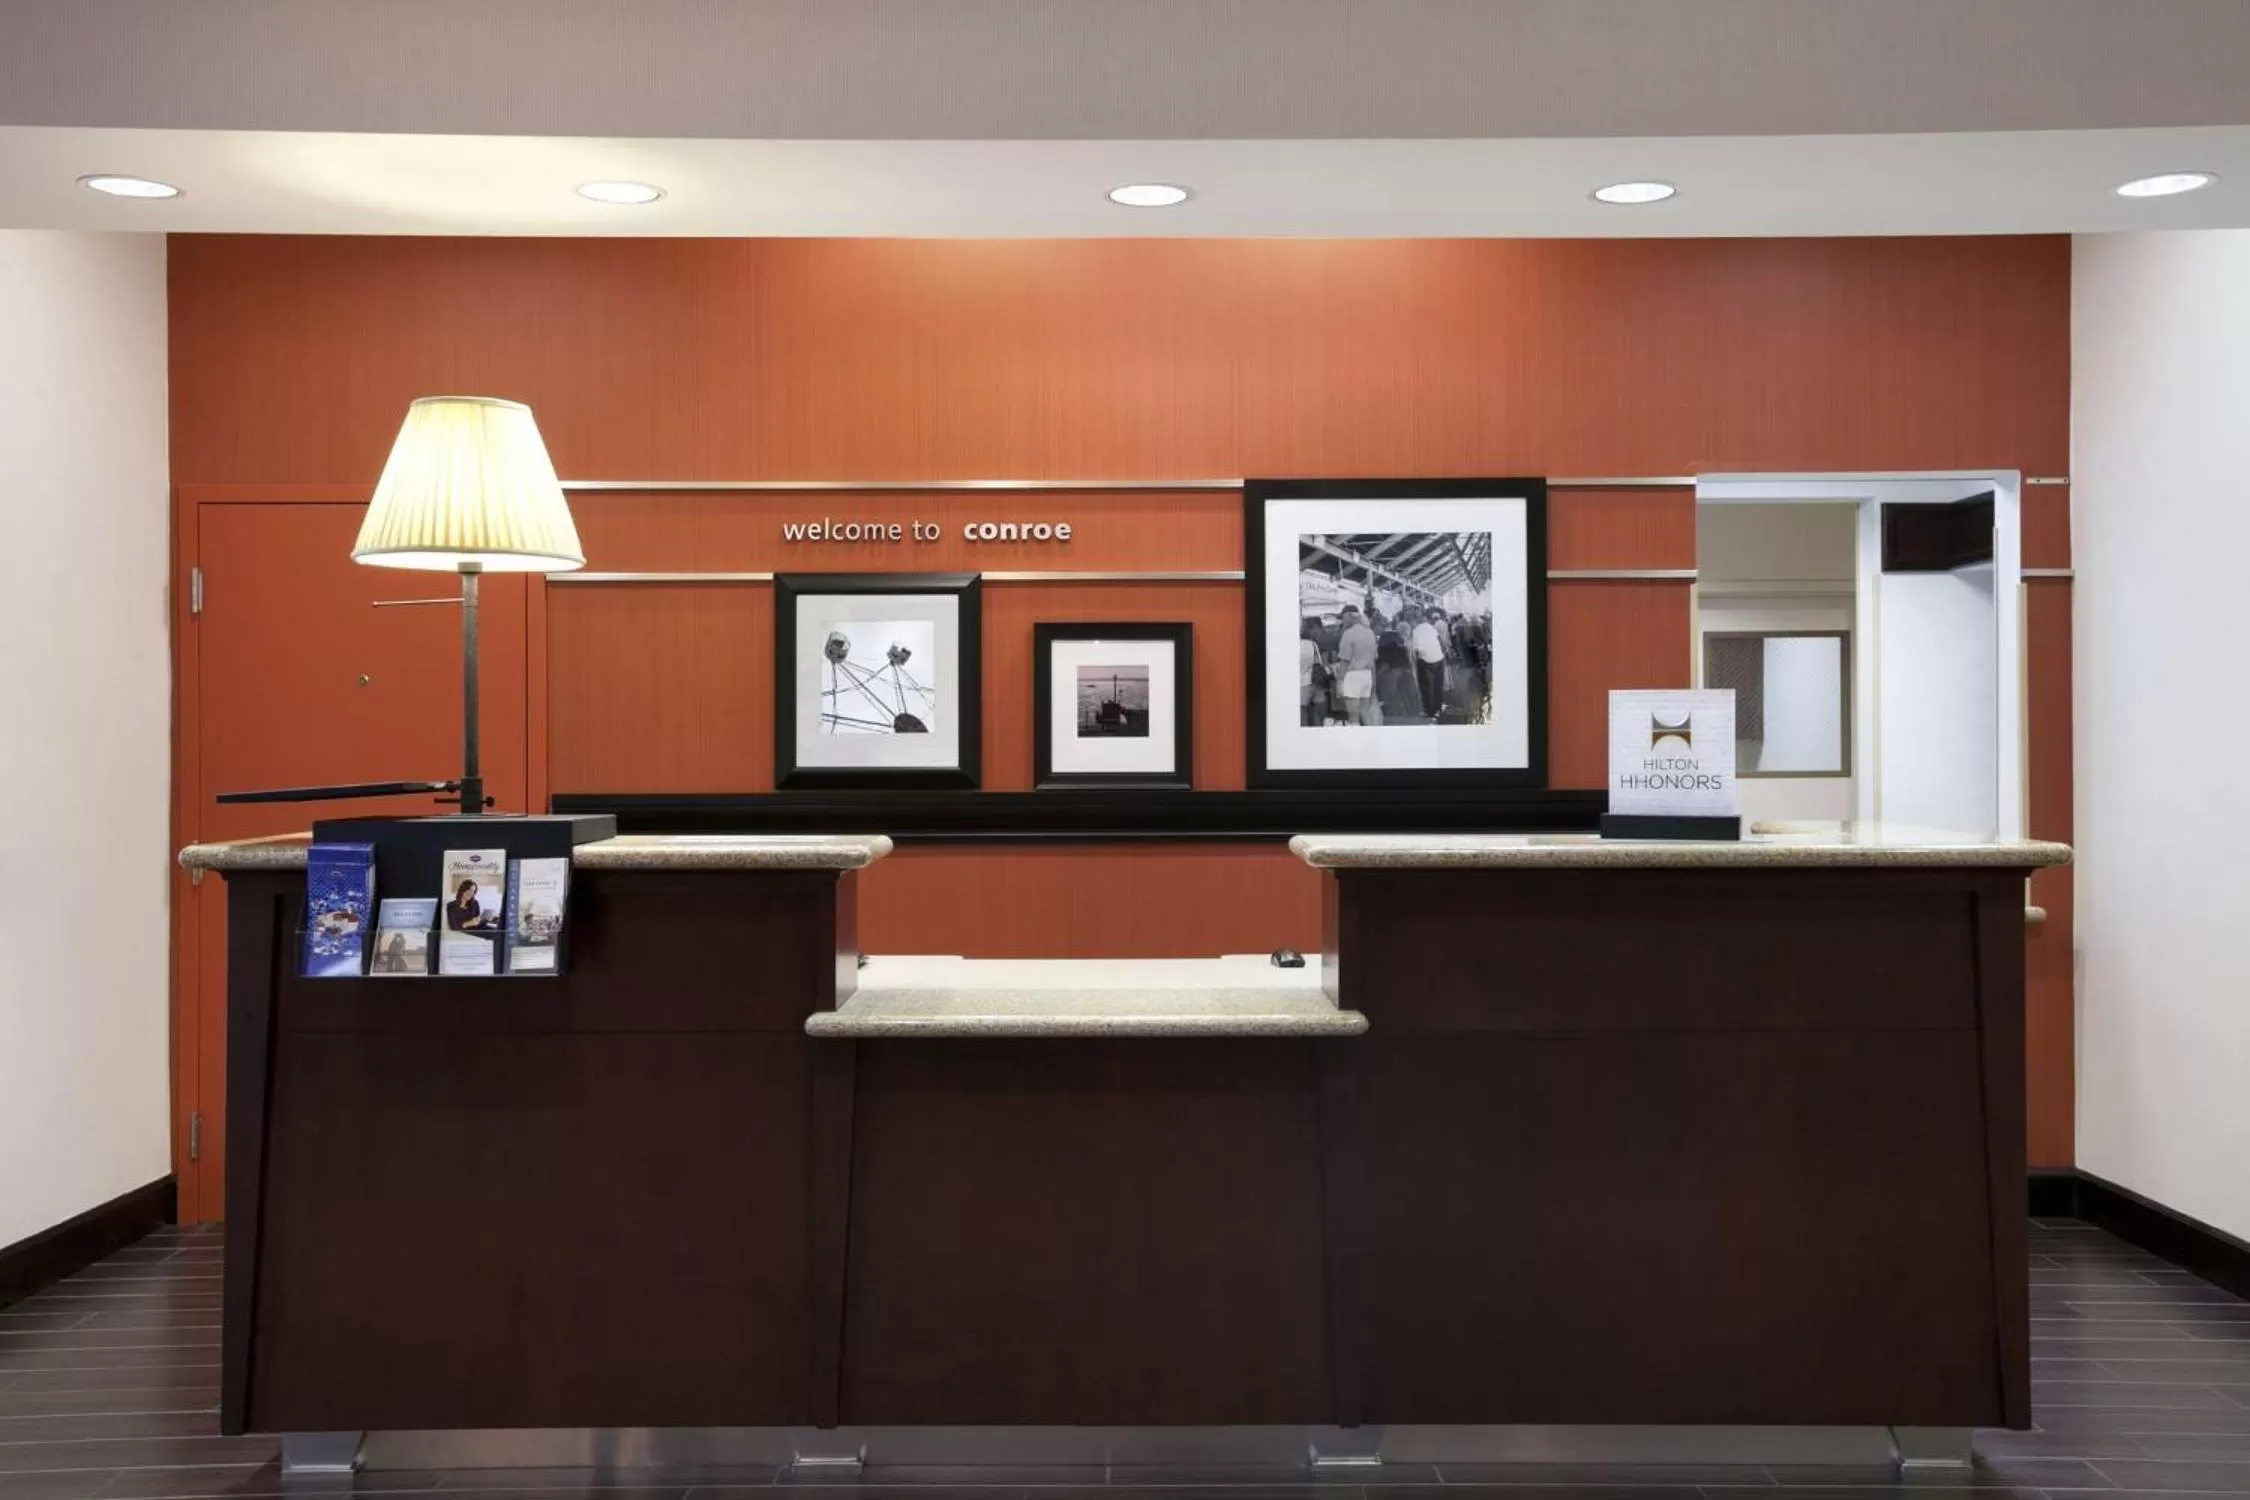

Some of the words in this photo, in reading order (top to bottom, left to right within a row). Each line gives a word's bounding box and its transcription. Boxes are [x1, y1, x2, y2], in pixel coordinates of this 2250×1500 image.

[783, 517, 902, 541] welcome
[911, 520, 941, 541] to
[963, 521, 1073, 541] conroe
[1643, 758, 1699, 770] HILTON
[1620, 774, 1722, 790] HHONORS
